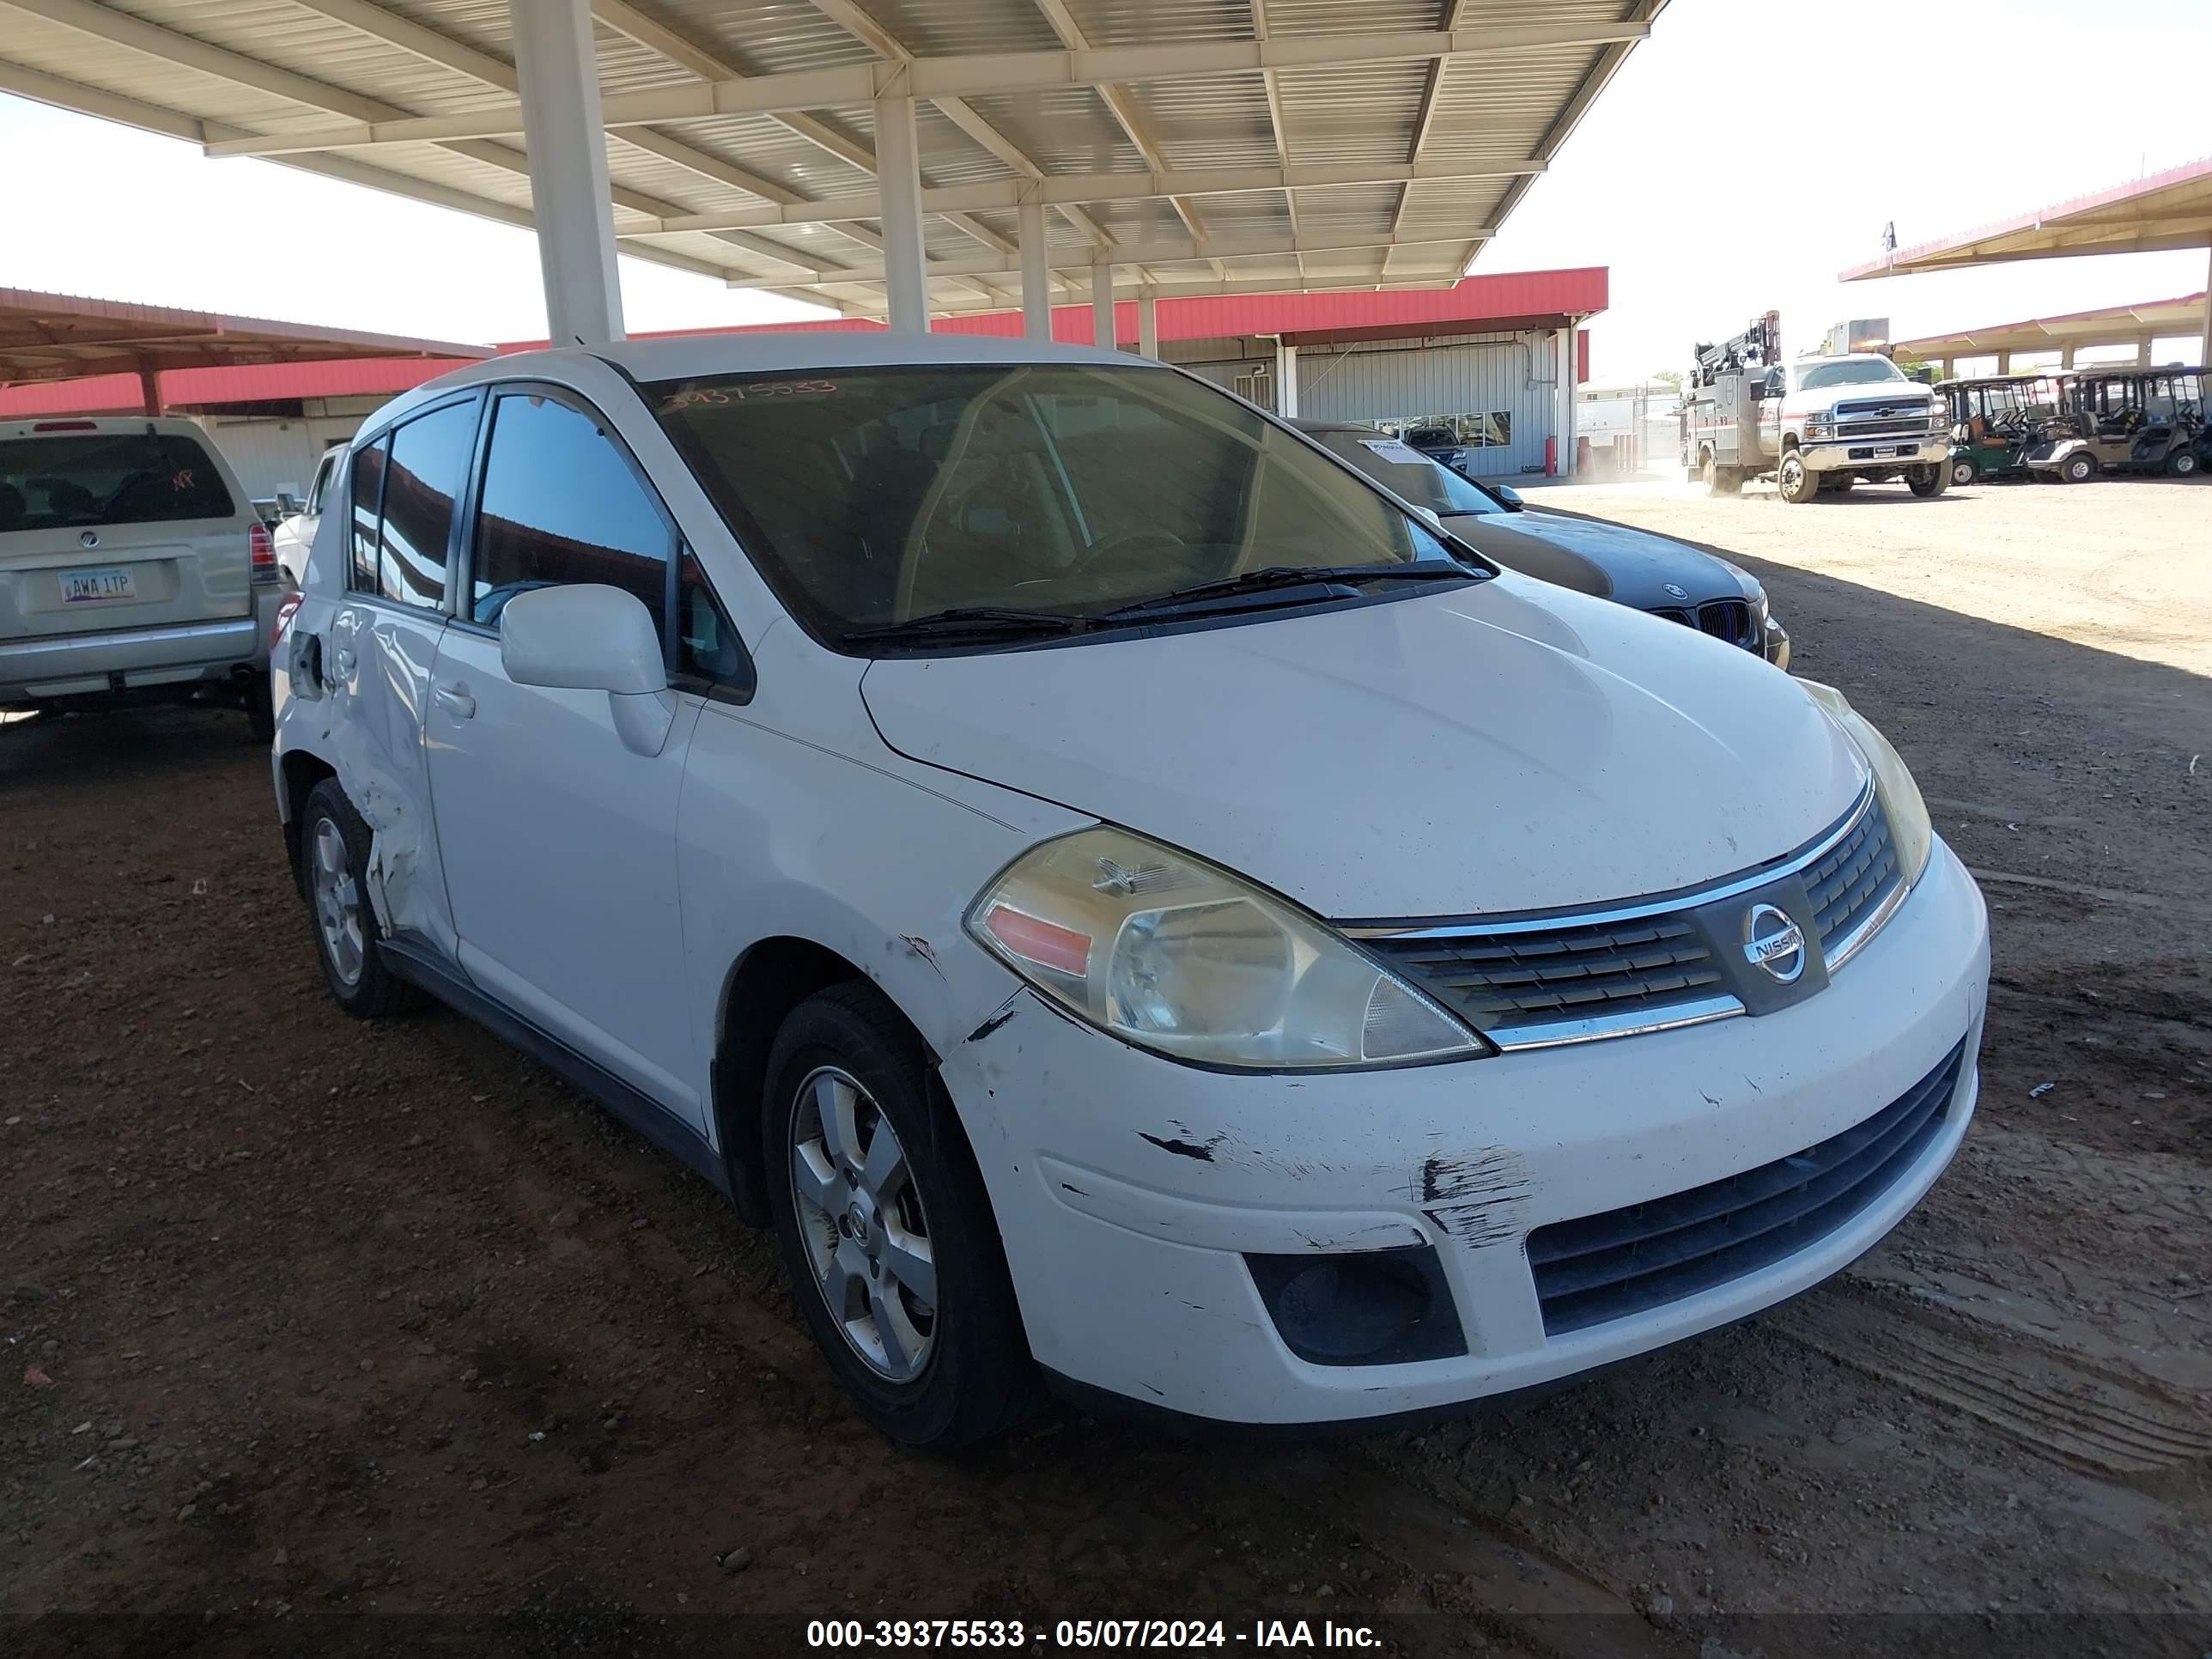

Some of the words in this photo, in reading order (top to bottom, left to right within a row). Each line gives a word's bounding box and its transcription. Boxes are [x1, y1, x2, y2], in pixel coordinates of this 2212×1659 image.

[663, 380, 837, 408] 39375533
[73, 578, 100, 596] AWA
[1755, 933, 1802, 958] NISSAN
